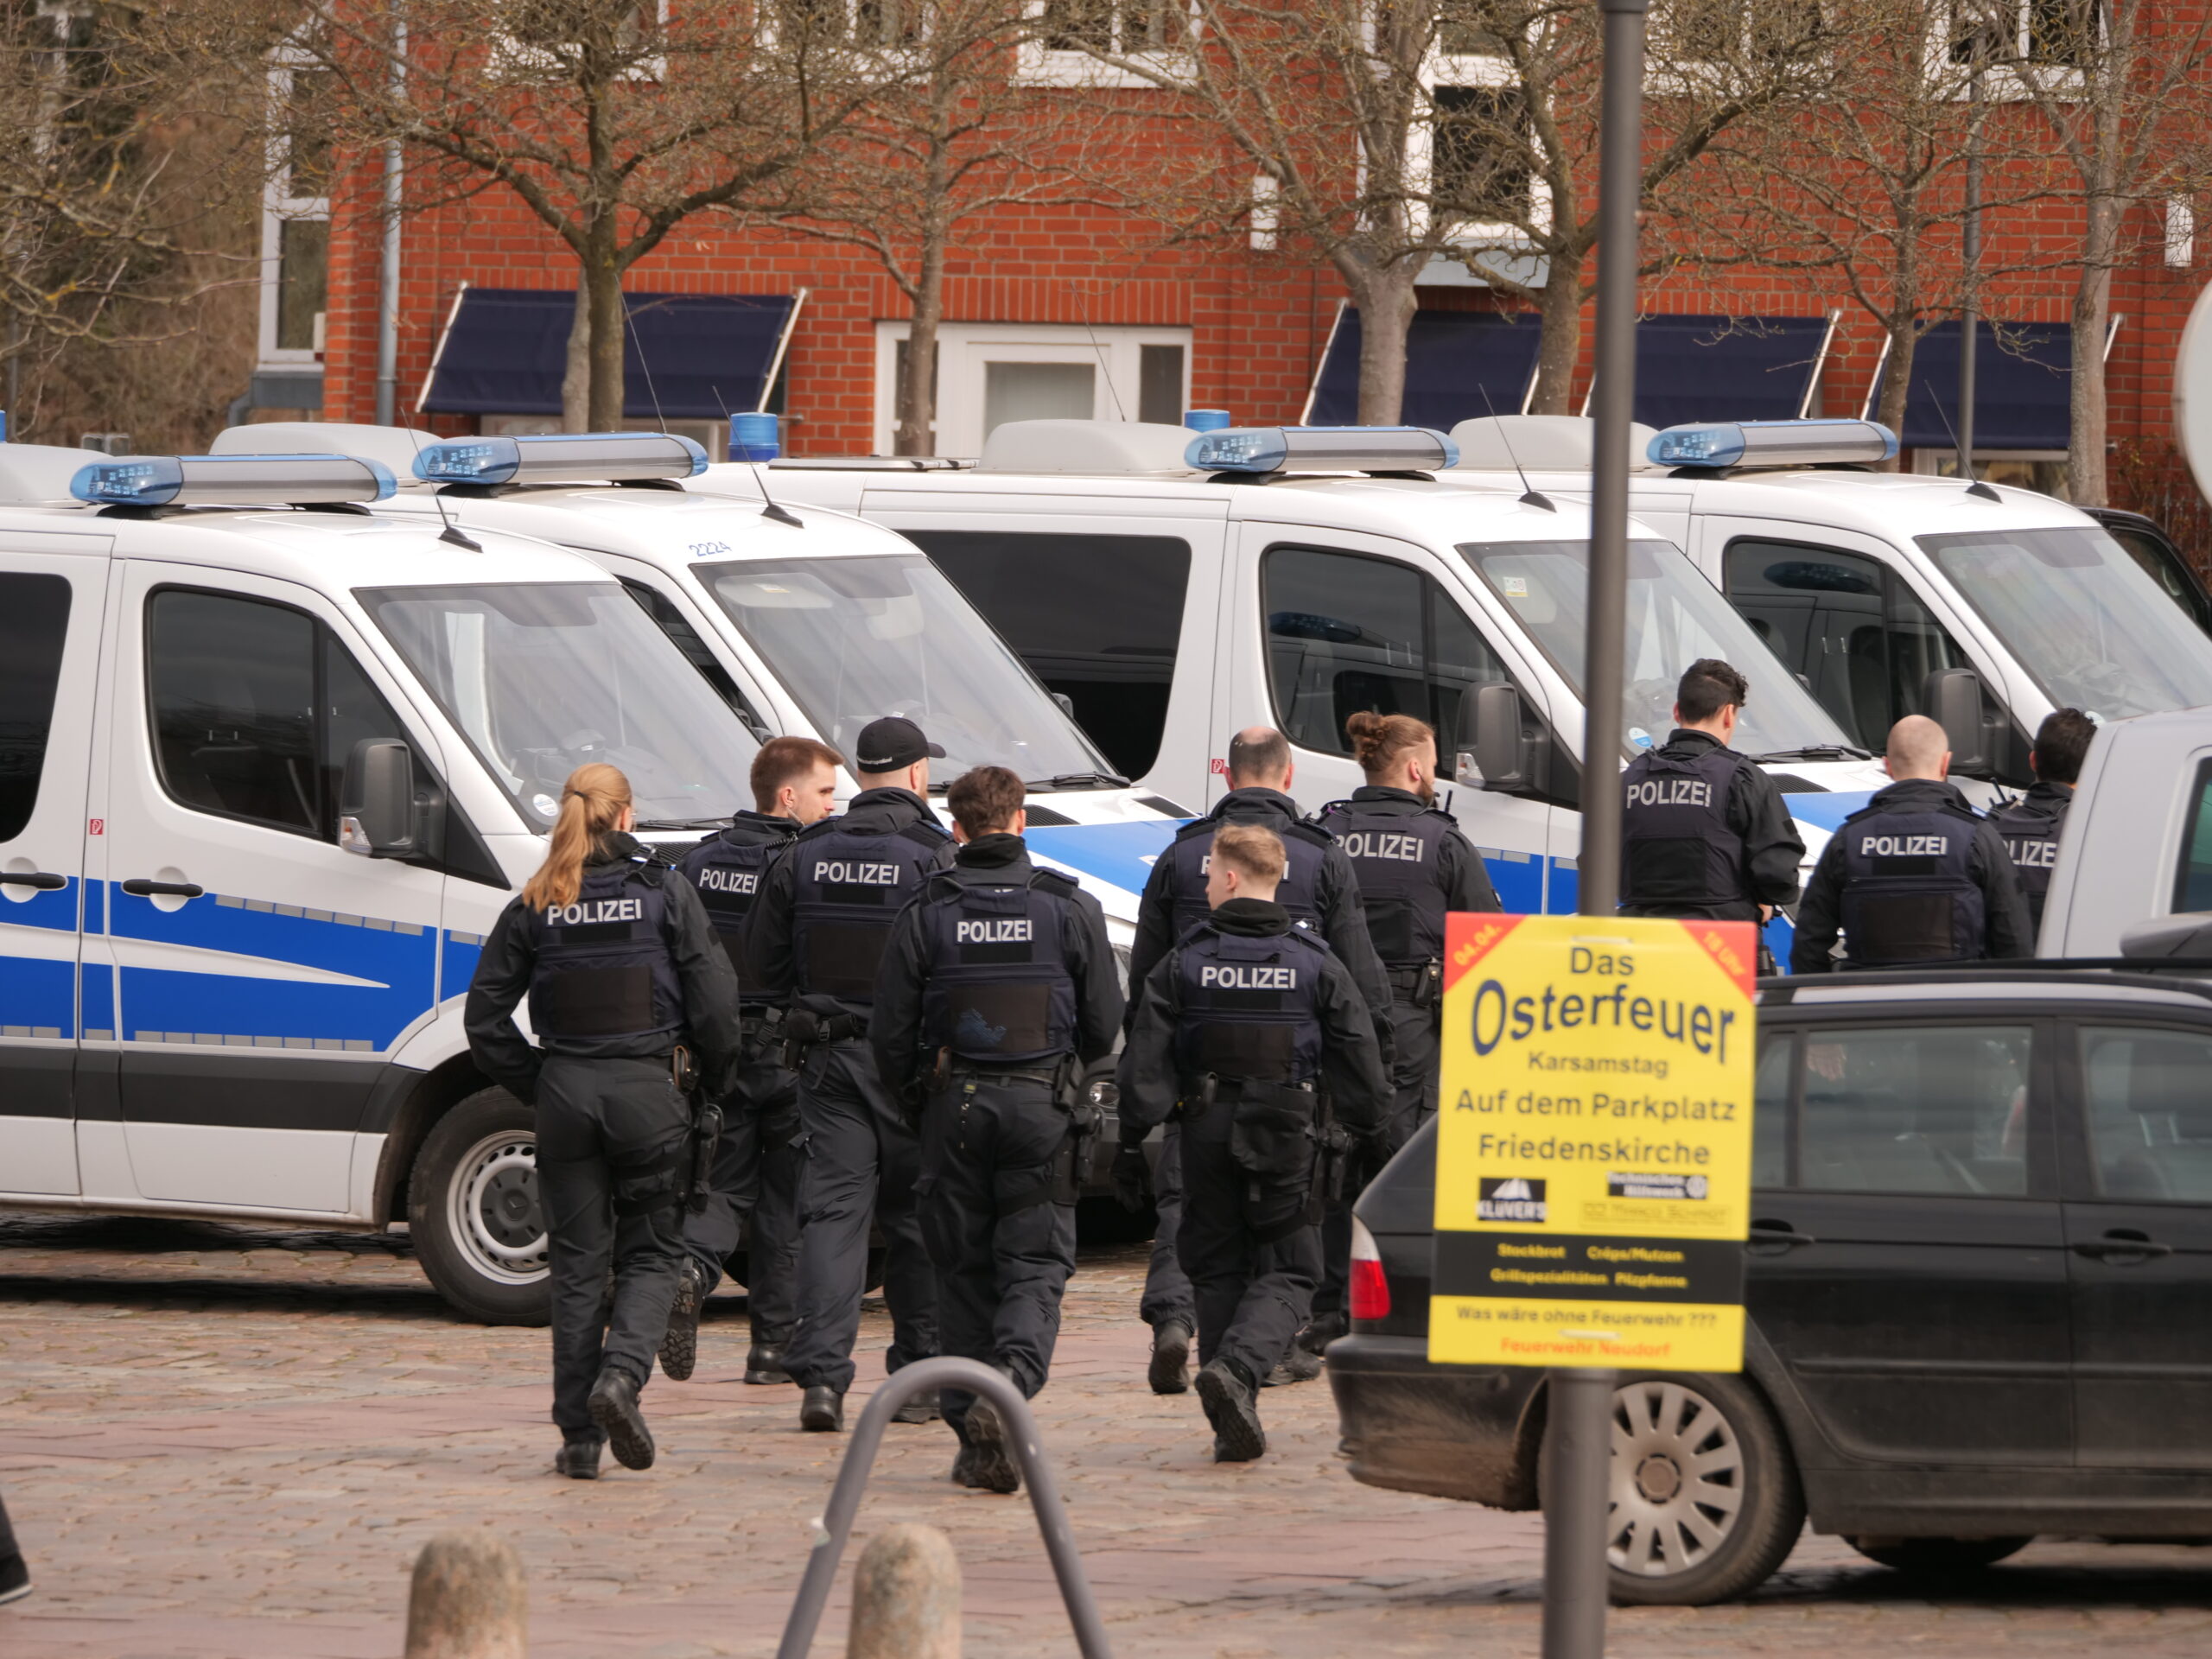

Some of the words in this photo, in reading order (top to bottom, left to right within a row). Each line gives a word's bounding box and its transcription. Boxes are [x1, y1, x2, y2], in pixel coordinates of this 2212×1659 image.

[689, 541, 732, 556] 2224
[1626, 779, 1712, 809] POLIZEI
[1861, 836, 1947, 856] POLIZEI
[2003, 840, 2057, 868] LIZE
[699, 868, 758, 894] POLIZEI
[814, 861, 899, 885] POLIZEI
[548, 899, 641, 925] POLIZEI
[957, 919, 1033, 943] POLIZEI
[1570, 947, 1635, 976] Das
[1201, 966, 1296, 989] POLIZEI
[1471, 979, 1734, 1064] Osterfeuer
[1528, 1051, 1669, 1080] Karsamstag
[1455, 1089, 1508, 1113] Auf
[1516, 1092, 1582, 1116] dem
[1592, 1094, 1736, 1122] Parkplatz
[1478, 1134, 1710, 1164] Friedenskirche
[1457, 1306, 1492, 1320] Was
[1497, 1306, 1538, 1322] wäre
[1543, 1308, 1586, 1324] ohne
[1592, 1310, 1683, 1326] Feuerwehr
[1688, 1313, 1718, 1328] ???
[1500, 1338, 1592, 1355] Feuerwehr
[1599, 1339, 1672, 1357] Neudorf
